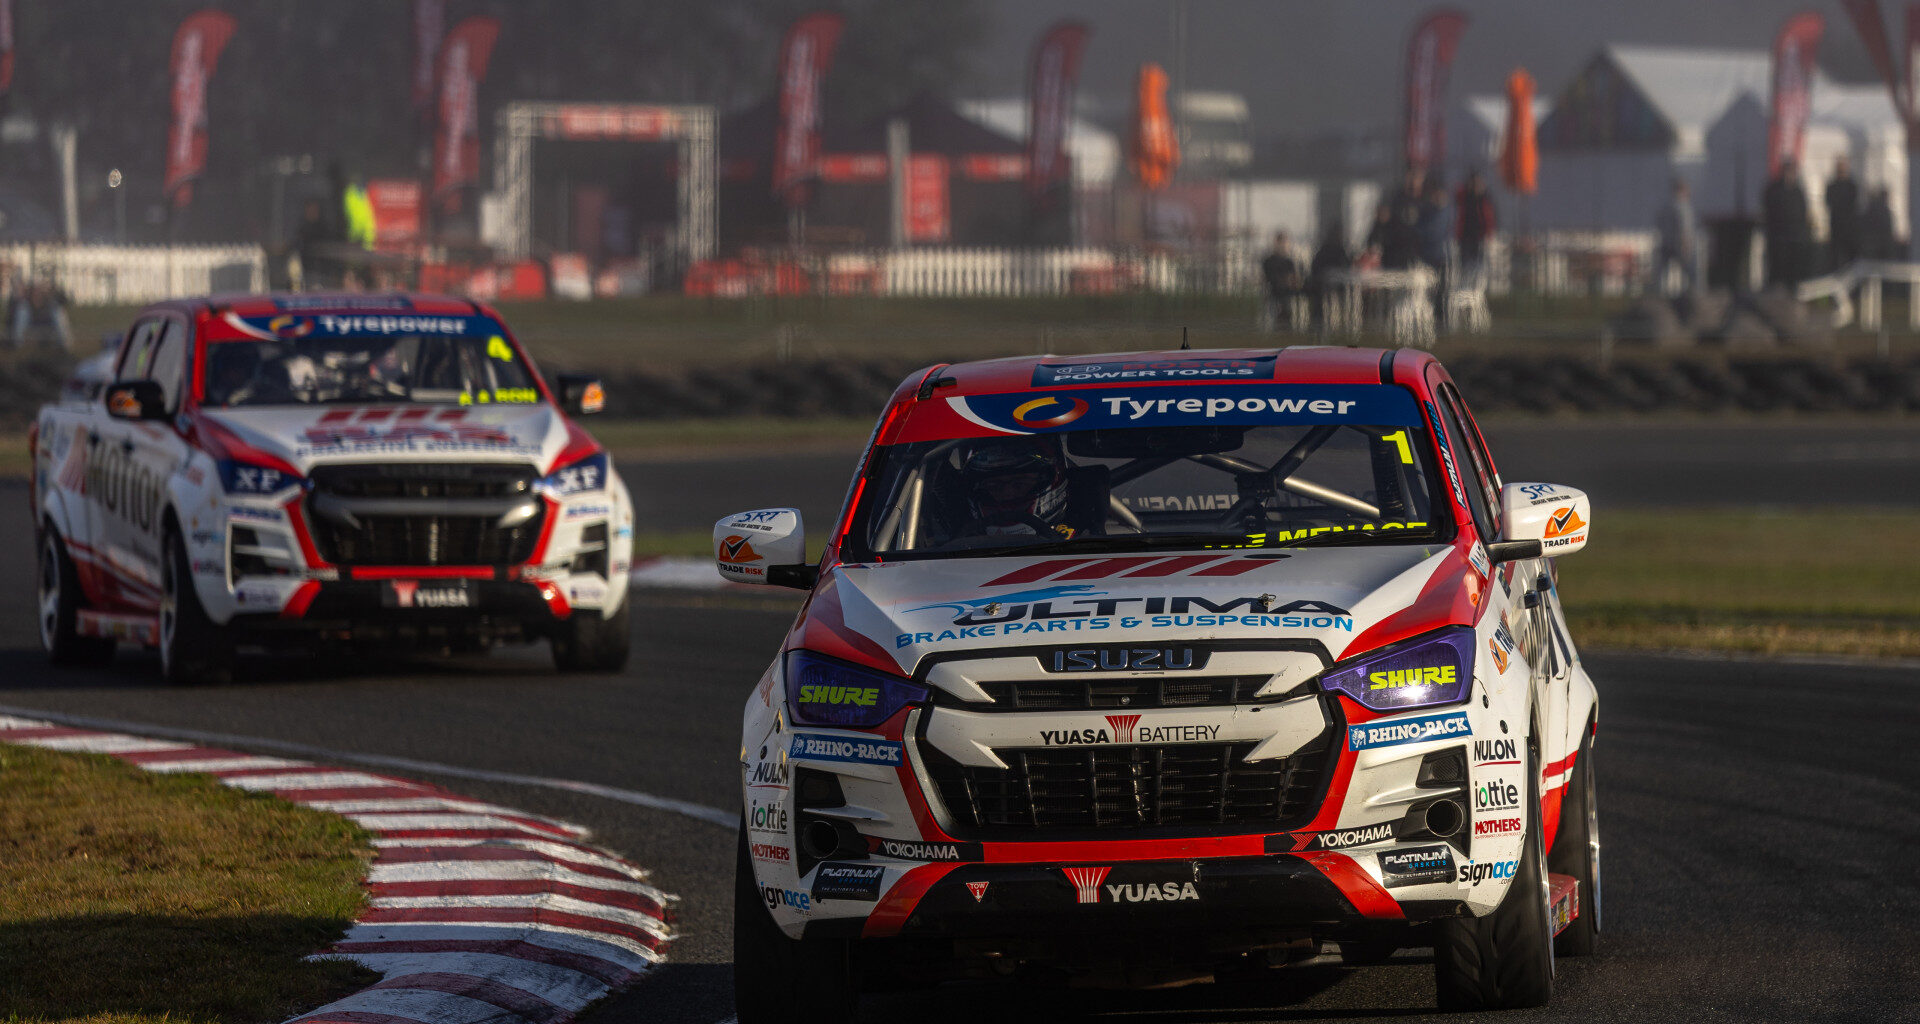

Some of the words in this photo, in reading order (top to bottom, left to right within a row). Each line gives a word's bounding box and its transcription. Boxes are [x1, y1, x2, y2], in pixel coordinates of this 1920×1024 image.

[320, 315, 466, 334] Tyrepower
[486, 335, 513, 361] 4
[1053, 370, 1157, 381] POWER
[1163, 368, 1254, 377] TOOLS
[1101, 397, 1356, 420] Tyrepower
[1381, 430, 1414, 464] 1
[235, 466, 281, 491] XF
[558, 465, 599, 494] XF
[1520, 484, 1555, 500] SRT
[737, 510, 789, 523] SRT
[1544, 537, 1570, 548] TRADE
[1570, 535, 1586, 544] RISK
[719, 562, 745, 574] TRADE
[745, 567, 764, 576] RISK
[415, 588, 469, 607] YUASA
[952, 596, 1353, 626] ULTIMA
[895, 625, 996, 650] BRAKE
[1003, 617, 1110, 635] PARTS
[1120, 616, 1143, 628] &
[1151, 615, 1353, 632] SUSPENSION
[1054, 648, 1193, 671] ISUZU
[1369, 665, 1456, 690] SHURE
[799, 685, 879, 706] SHURE
[1040, 728, 1110, 745] YUASA
[1139, 724, 1220, 742] BATTERY
[1368, 717, 1468, 744] RHINO-RACK
[804, 739, 899, 761] RHINO-RACK
[1474, 738, 1517, 762] NULON
[752, 761, 789, 784] NULON
[1474, 777, 1519, 808] iottie
[750, 798, 788, 830] iottie
[1318, 824, 1393, 848] YOKOHAMA
[1475, 817, 1521, 835] MOTHERS
[882, 840, 959, 860] YOKOHAMA
[1384, 851, 1447, 865] PLATINUM
[821, 867, 879, 878] PLATINUM
[1408, 860, 1447, 869] GASKETS
[760, 881, 810, 910] ignace
[1106, 882, 1200, 902] YUASA
